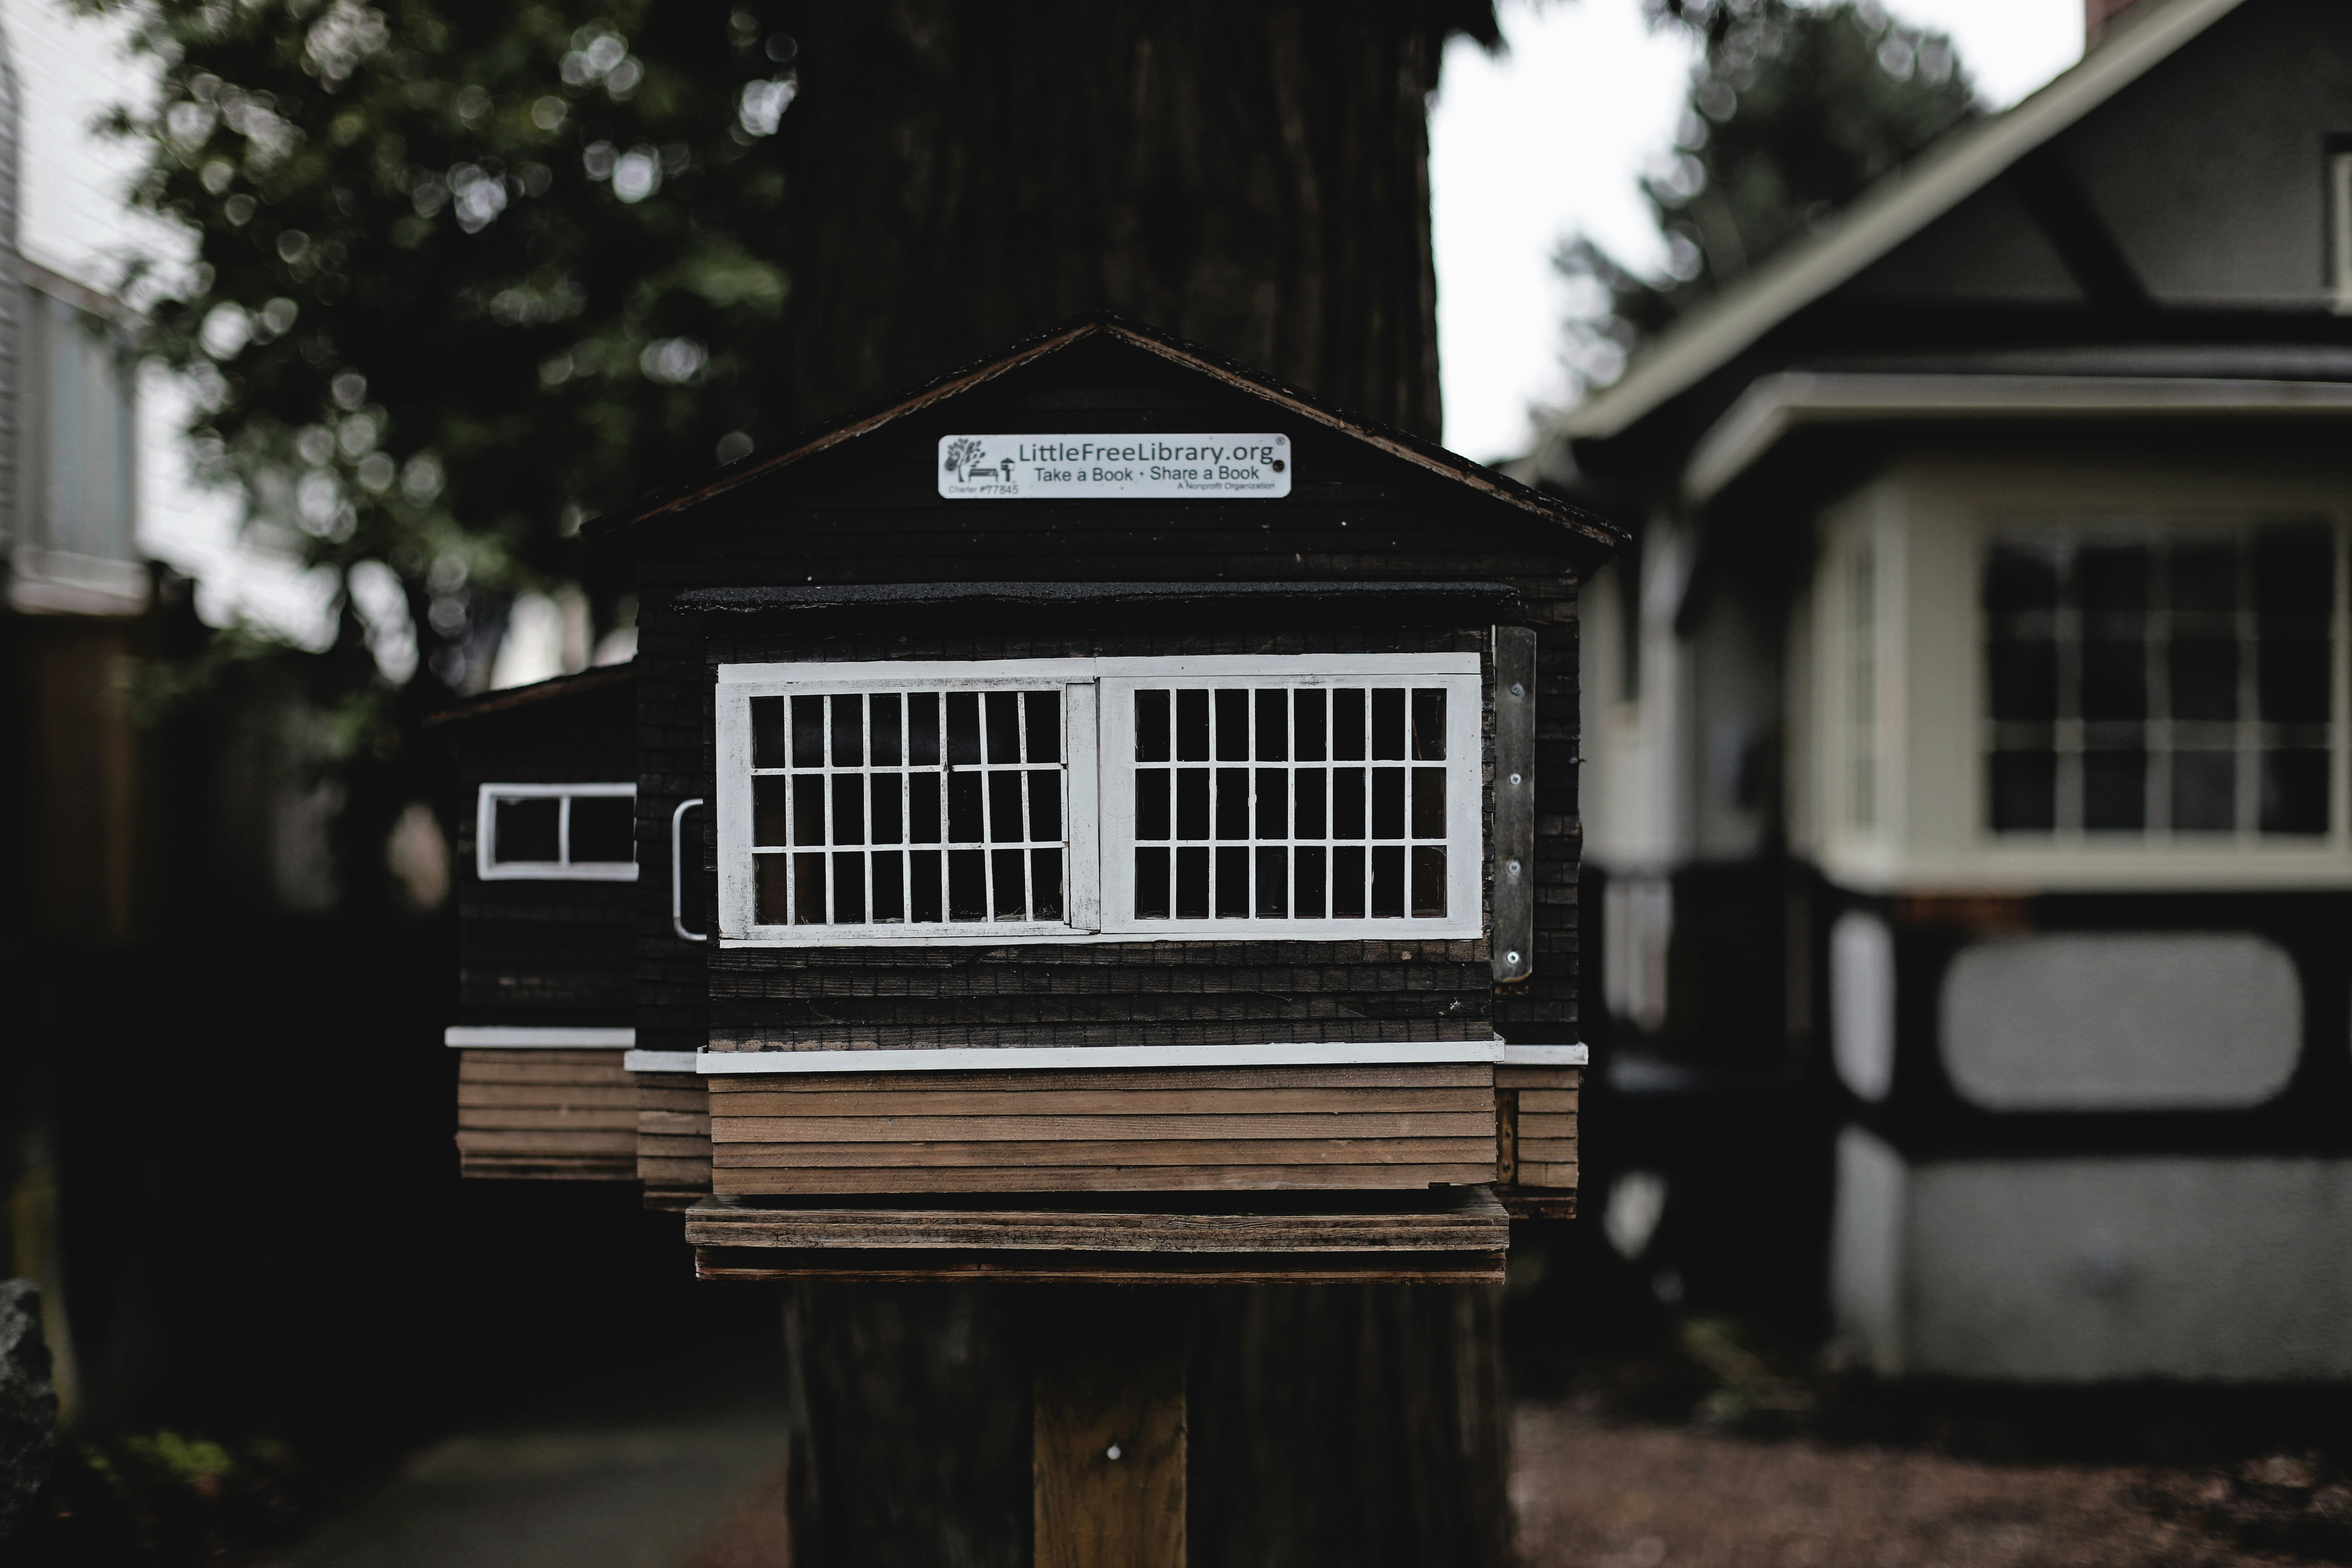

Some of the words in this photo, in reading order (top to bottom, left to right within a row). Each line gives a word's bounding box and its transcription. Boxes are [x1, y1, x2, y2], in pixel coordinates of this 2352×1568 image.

[1020, 442, 1274, 465] LittleFreeLibrary.org
[1035, 467, 1072, 482] Take
[1077, 470, 1087, 482] a
[1093, 467, 1133, 482] Book
[1150, 466, 1197, 480] Share
[1204, 469, 1213, 480] a
[1219, 466, 1259, 480] Book
[948, 485, 978, 493] Charter
[1186, 482, 1222, 490] Nonprofit
[1225, 482, 1275, 491] Organization
